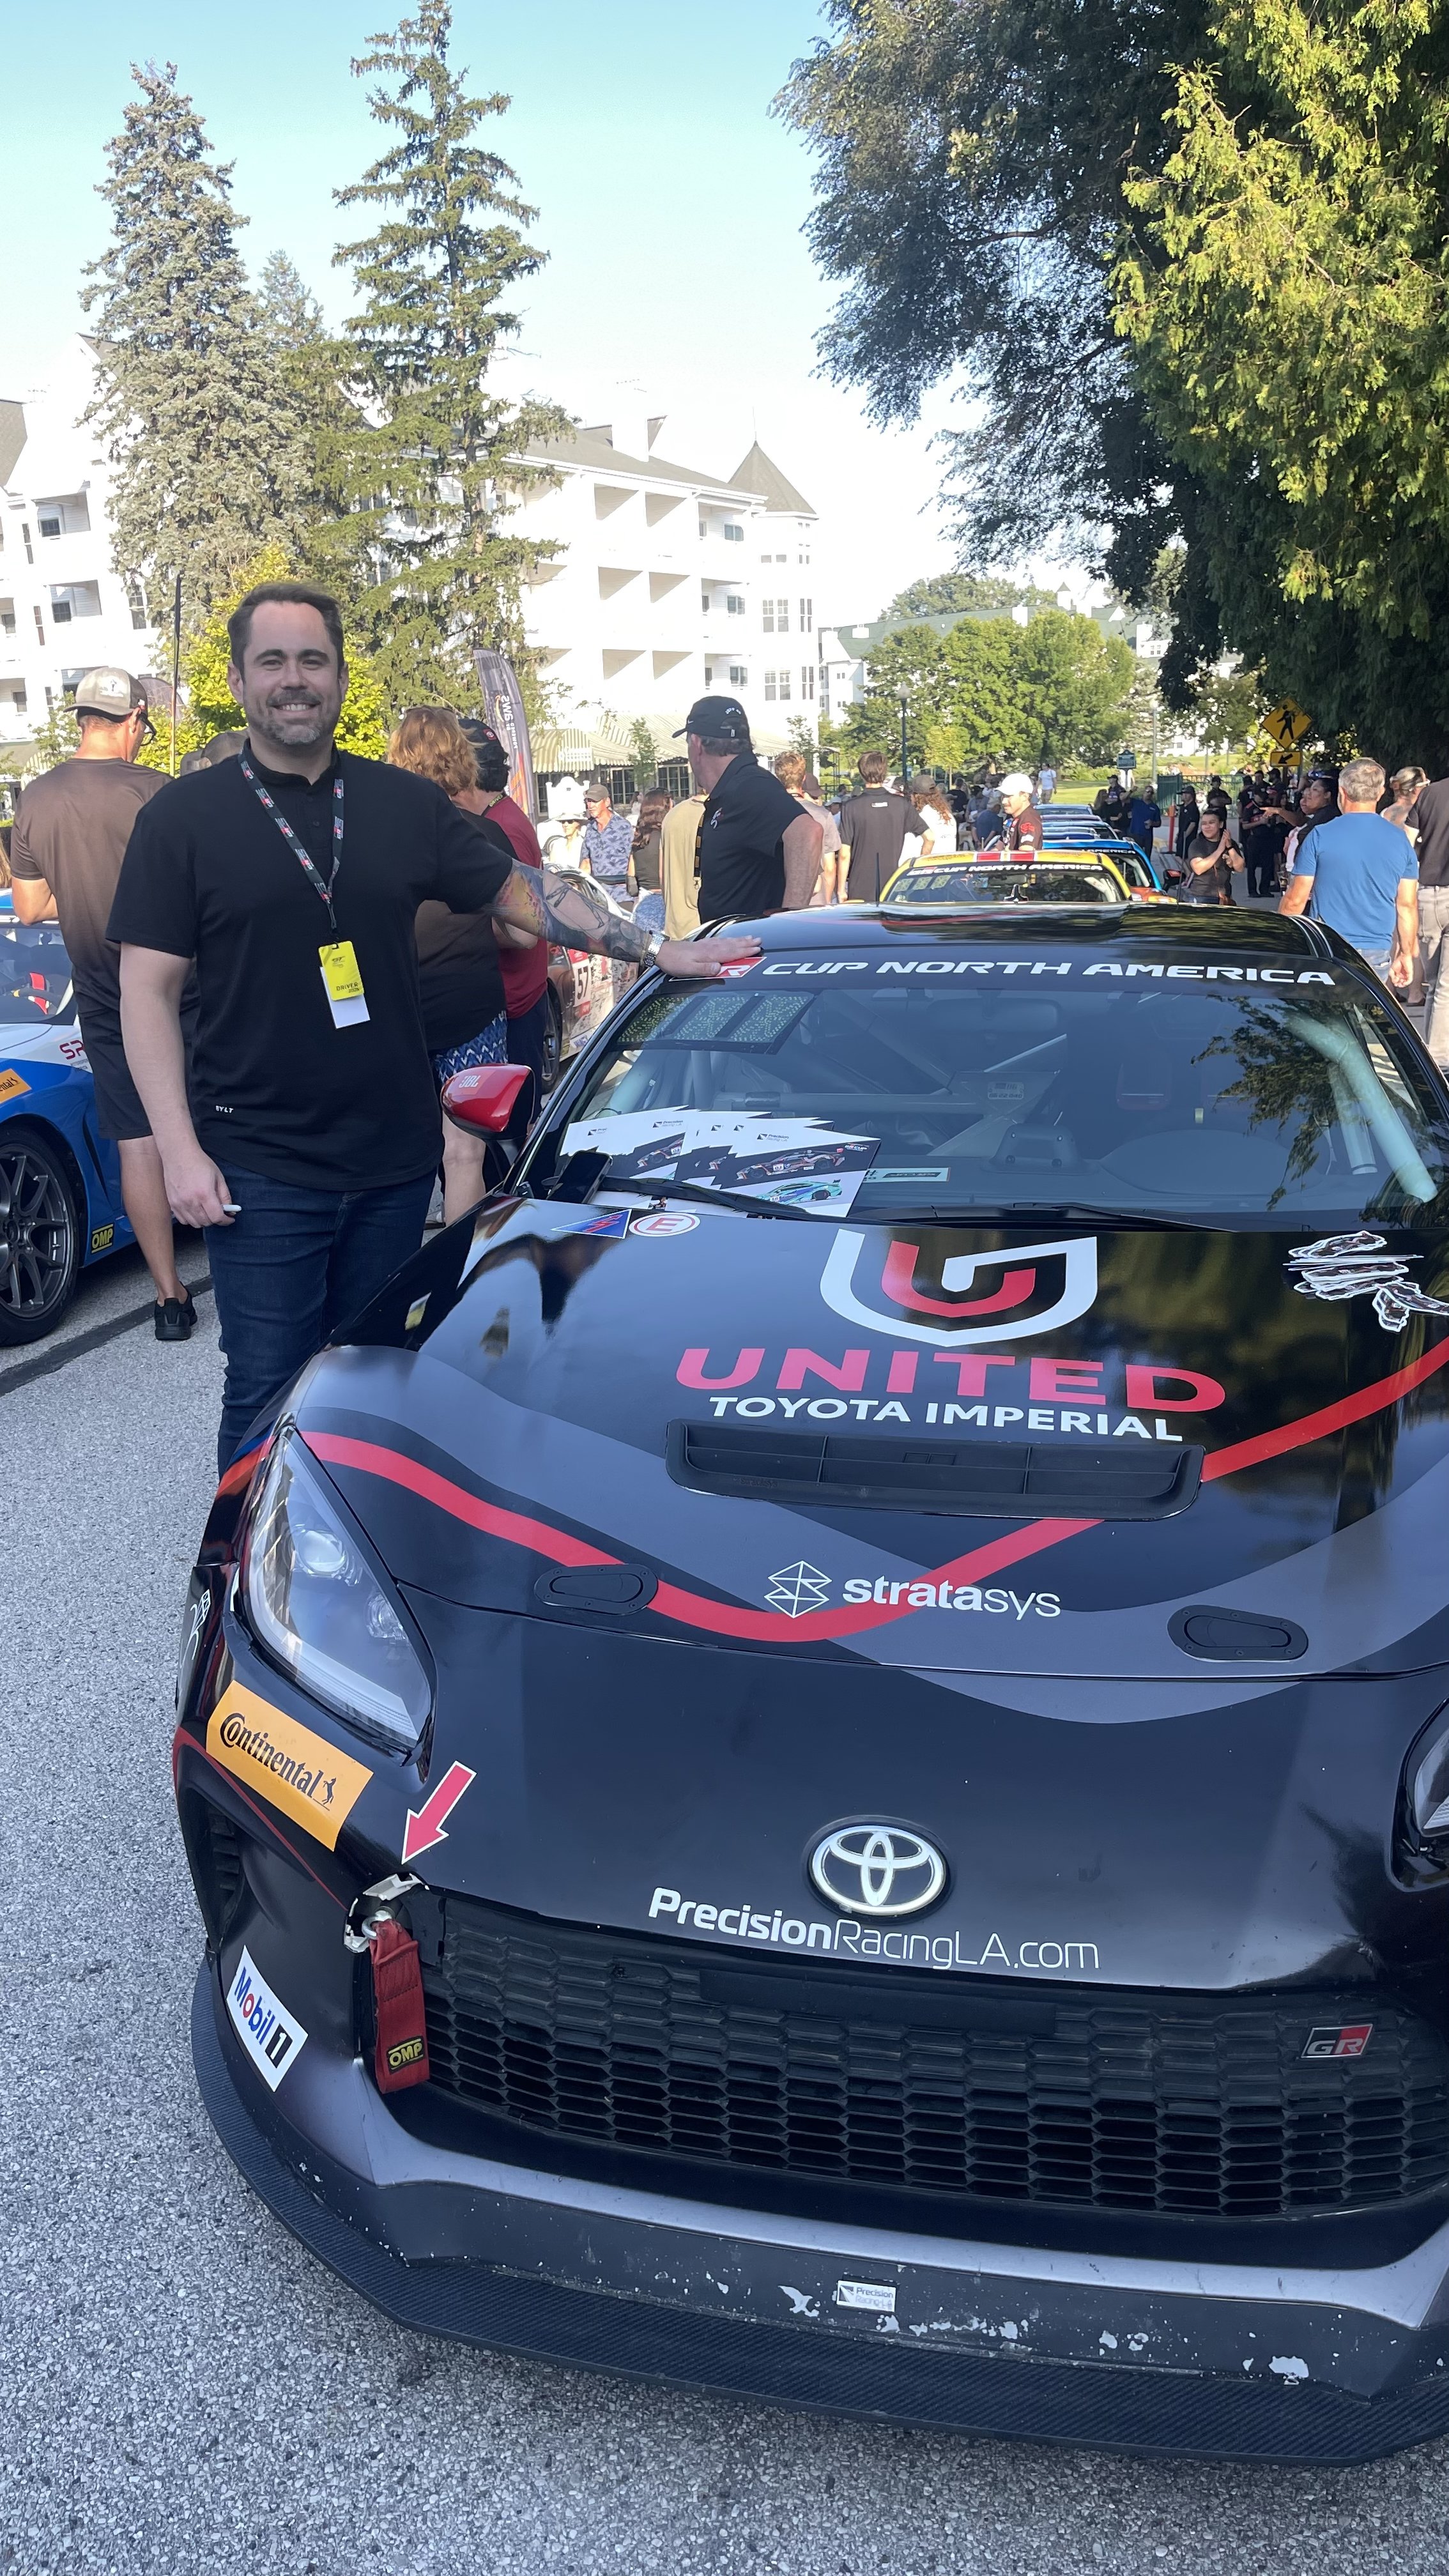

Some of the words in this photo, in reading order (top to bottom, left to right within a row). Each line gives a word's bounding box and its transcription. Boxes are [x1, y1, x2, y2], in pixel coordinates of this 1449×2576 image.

[336, 982, 358, 992] DRIVER
[576, 965, 589, 1000] 57
[763, 962, 869, 975] CUP
[877, 962, 1072, 975] NORTH
[1082, 963, 1336, 986] AMERICA
[459, 1075, 481, 1089] JBL
[646, 1217, 684, 1232] E
[92, 1228, 113, 1249] OMP
[676, 1349, 1225, 1413] UNITED
[709, 1397, 910, 1423] TOYOTA
[925, 1402, 1183, 1443] IMPERIAL
[843, 1575, 1061, 1621] stratasys
[220, 1712, 325, 1800] Continental
[648, 1887, 1100, 1970] PrecisionRacingLA.com
[233, 1966, 276, 2046] Mobil
[270, 2032, 288, 2059] 1
[389, 2041, 423, 2070] OMP
[1306, 2038, 1365, 2055] GR
[855, 2296, 879, 2306] Racing
[856, 2287, 893, 2298] Precision
